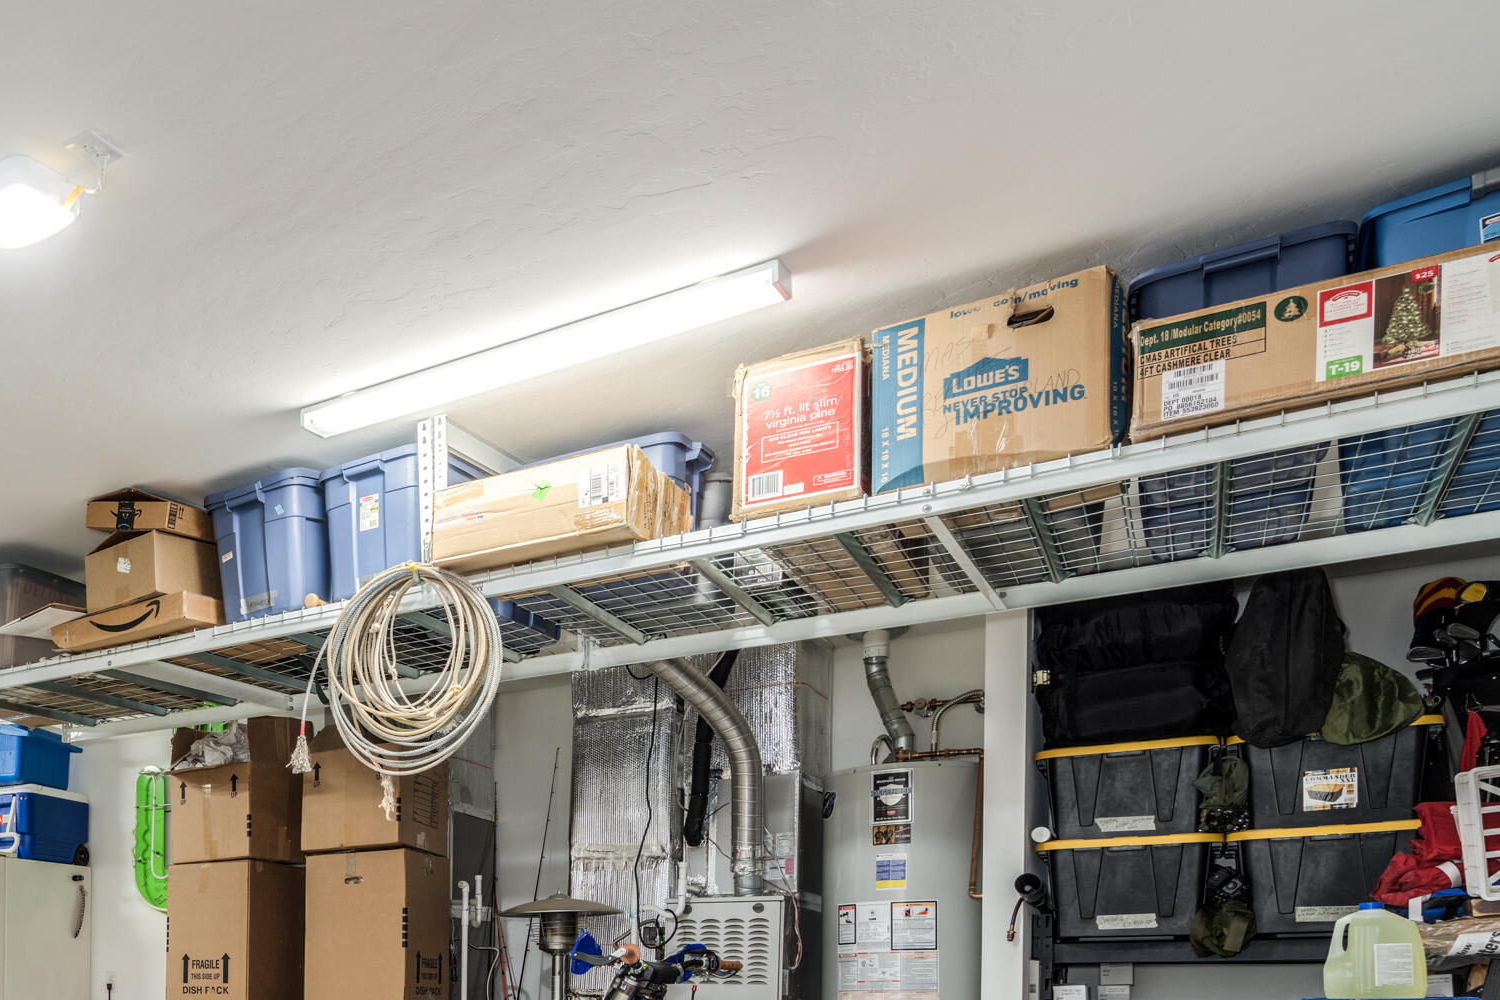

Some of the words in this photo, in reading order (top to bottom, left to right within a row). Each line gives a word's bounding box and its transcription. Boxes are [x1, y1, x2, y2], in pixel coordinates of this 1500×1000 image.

[1414, 269, 1434, 280] $25
[1140, 335, 1159, 348] Dept.
[1160, 330, 1170, 342] 18
[881, 335, 891, 381] MEDIANA
[1140, 352, 1163, 365] CMAS
[1164, 341, 1208, 359] ARTIFICAL
[1209, 334, 1238, 350] TREES
[1139, 364, 1154, 377] 4FT
[1156, 354, 1201, 374] CASHMERE
[1203, 348, 1231, 364] CLEAR
[1328, 360, 1361, 376] T-19
[895, 325, 921, 441] MEDIUM
[949, 364, 1022, 394] LOWE'S
[752, 385, 771, 399] 16
[942, 394, 988, 415] NEVER
[991, 385, 1028, 404] STOP
[783, 405, 797, 416] ft.
[798, 402, 811, 414] lit
[812, 396, 838, 410] slim
[954, 384, 1086, 426] IMPROVING
[765, 414, 807, 431] virginia
[808, 406, 837, 422] pine
[880, 427, 890, 438] 18
[880, 448, 890, 460] 18
[1304, 773, 1357, 781] COMMANDER
[191, 959, 220, 970] FRAGILE
[182, 986, 203, 995] DISH
